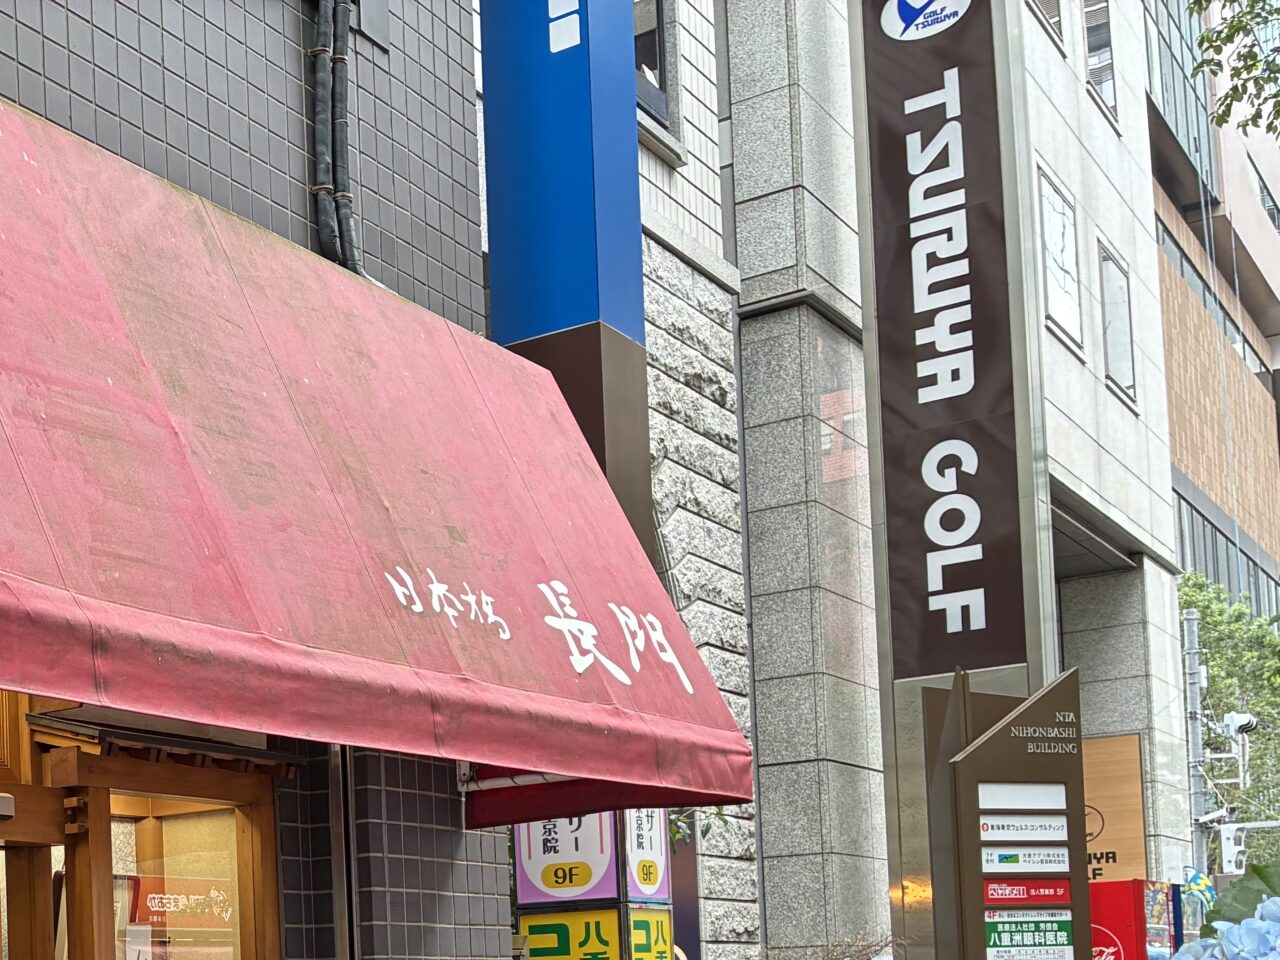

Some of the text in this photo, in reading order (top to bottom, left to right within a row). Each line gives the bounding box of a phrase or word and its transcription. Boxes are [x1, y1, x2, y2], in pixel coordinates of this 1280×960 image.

[914, 10, 959, 31] TSURUYA
[923, 6, 947, 20] GOLF
[903, 67, 987, 634] TSURUYA GOLF
[537, 580, 694, 694] 長門
[1055, 711, 1077, 723] NTA
[1010, 726, 1077, 738] NIHONBASHI
[1027, 742, 1078, 754] BUILDING
[554, 866, 581, 885] 9F
[642, 864, 654, 882] 9F
[987, 910, 998, 920] 4F
[989, 931, 1069, 946] 八重洲眼科医院
